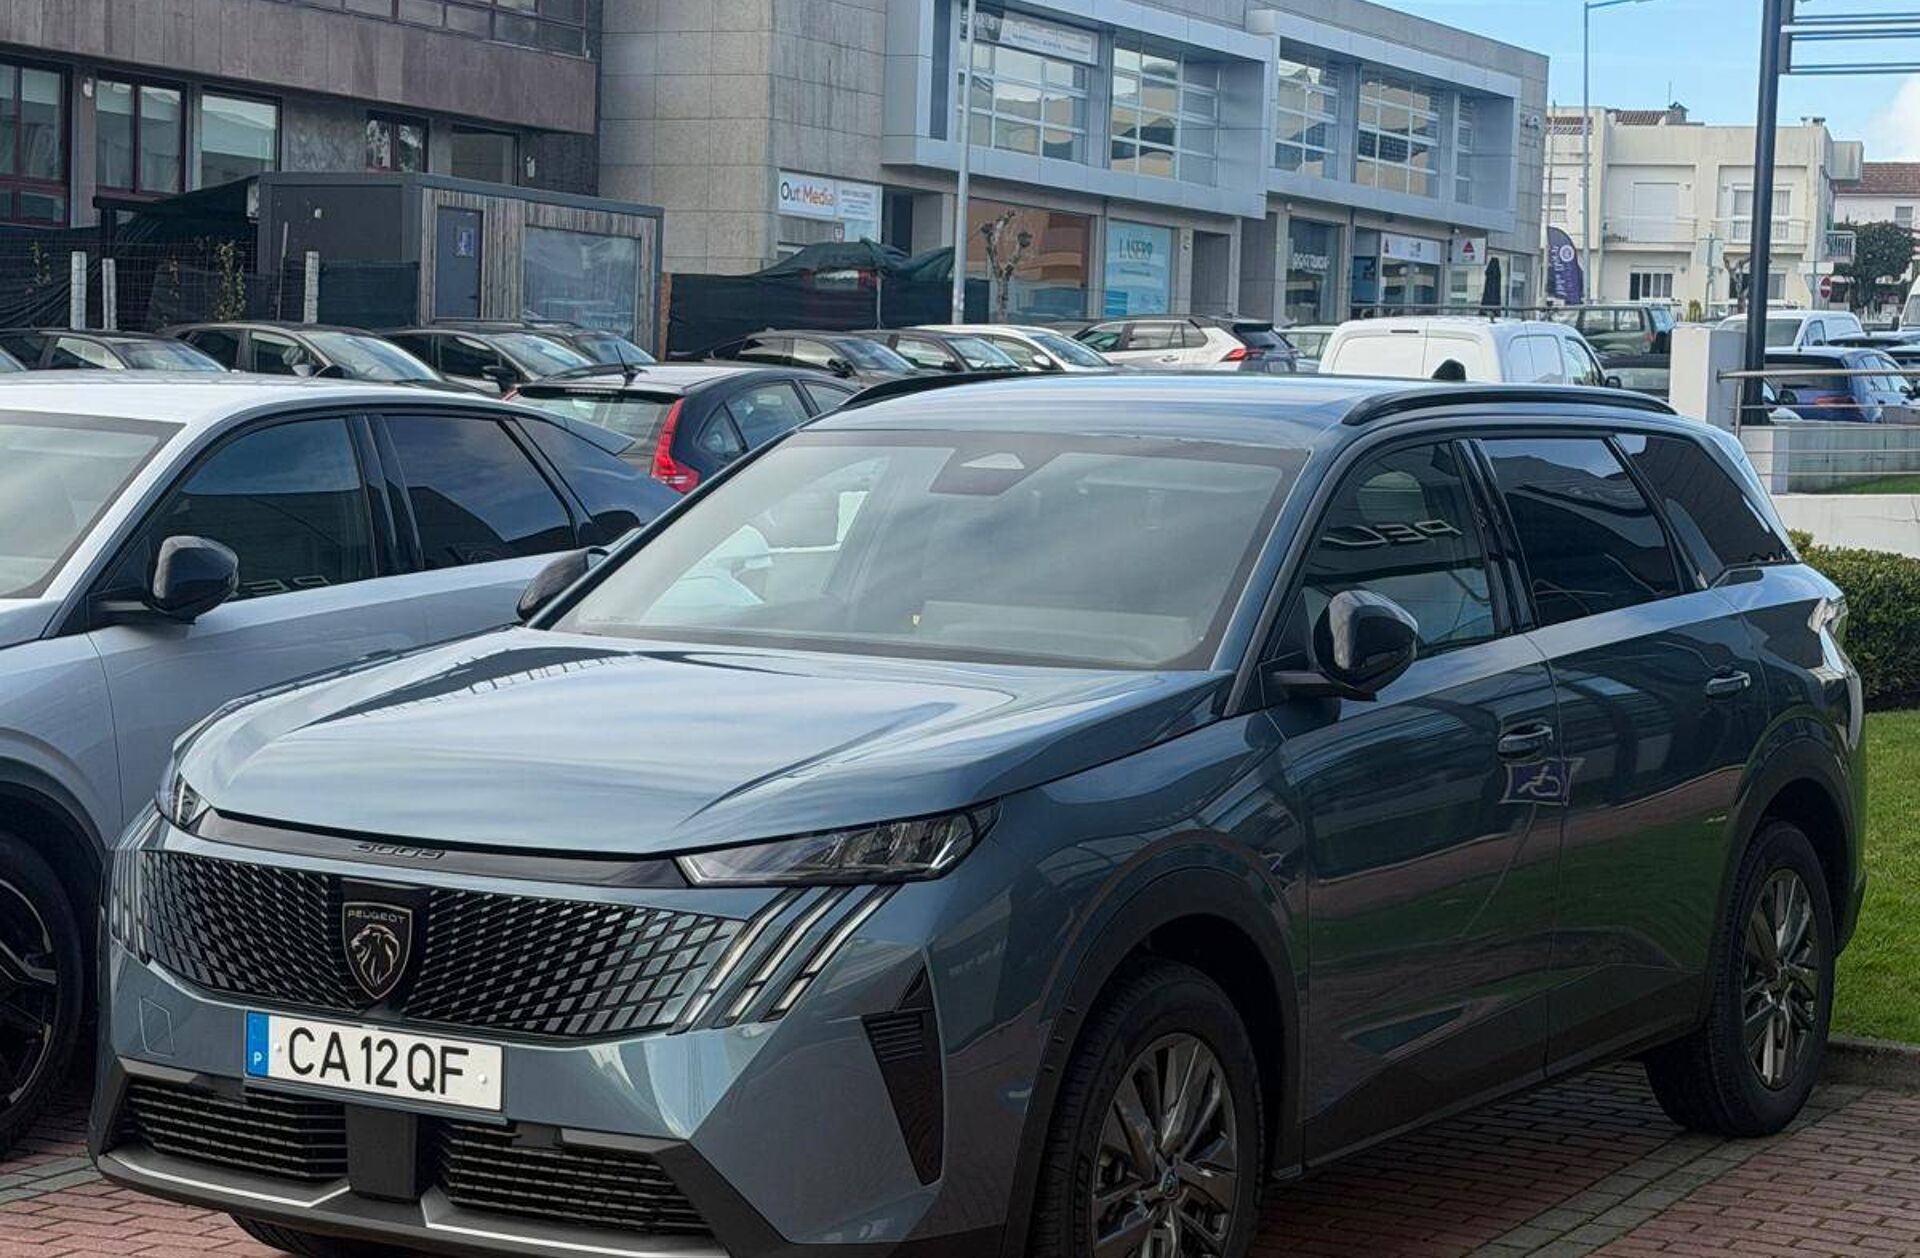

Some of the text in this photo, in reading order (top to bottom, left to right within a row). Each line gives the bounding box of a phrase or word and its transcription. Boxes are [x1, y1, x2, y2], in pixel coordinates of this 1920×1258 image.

[347, 909, 407, 923] PEUGEOT
[253, 1051, 263, 1066] P
[288, 1026, 470, 1095] CA 12 QF
